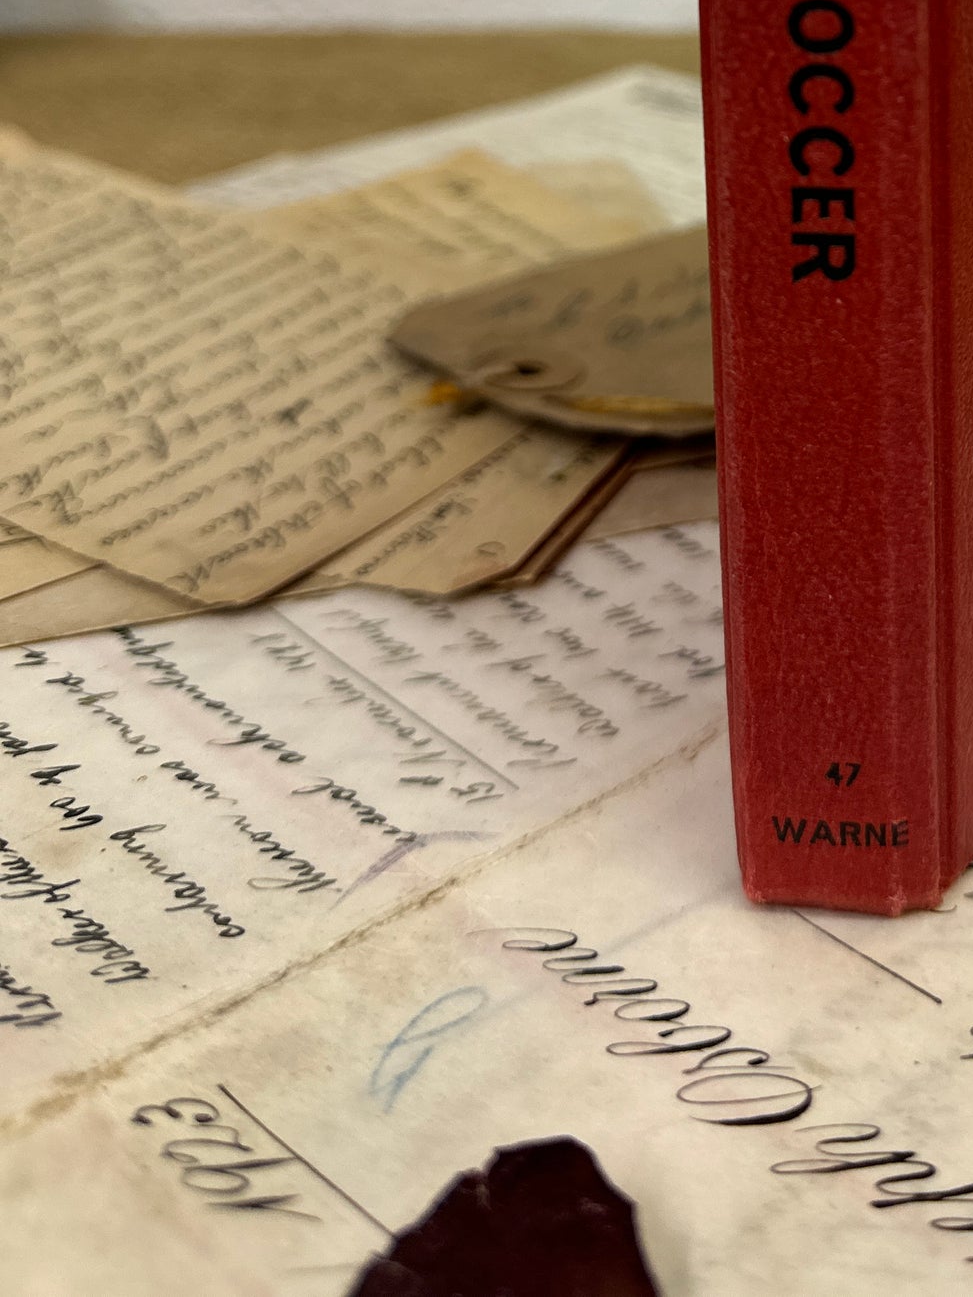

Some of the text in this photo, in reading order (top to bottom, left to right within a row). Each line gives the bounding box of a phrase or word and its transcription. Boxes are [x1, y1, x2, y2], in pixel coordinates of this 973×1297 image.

[43, 671, 161, 756] conveyed
[157, 760, 238, 806] was
[824, 762, 862, 786] 47
[48, 797, 103, 832] 600
[772, 815, 909, 847] WARNE
[100, 824, 246, 939] containing
[49, 909, 151, 986] Walker
[466, 927, 824, 1128] Osborne
[130, 1097, 322, 1224] 1923
